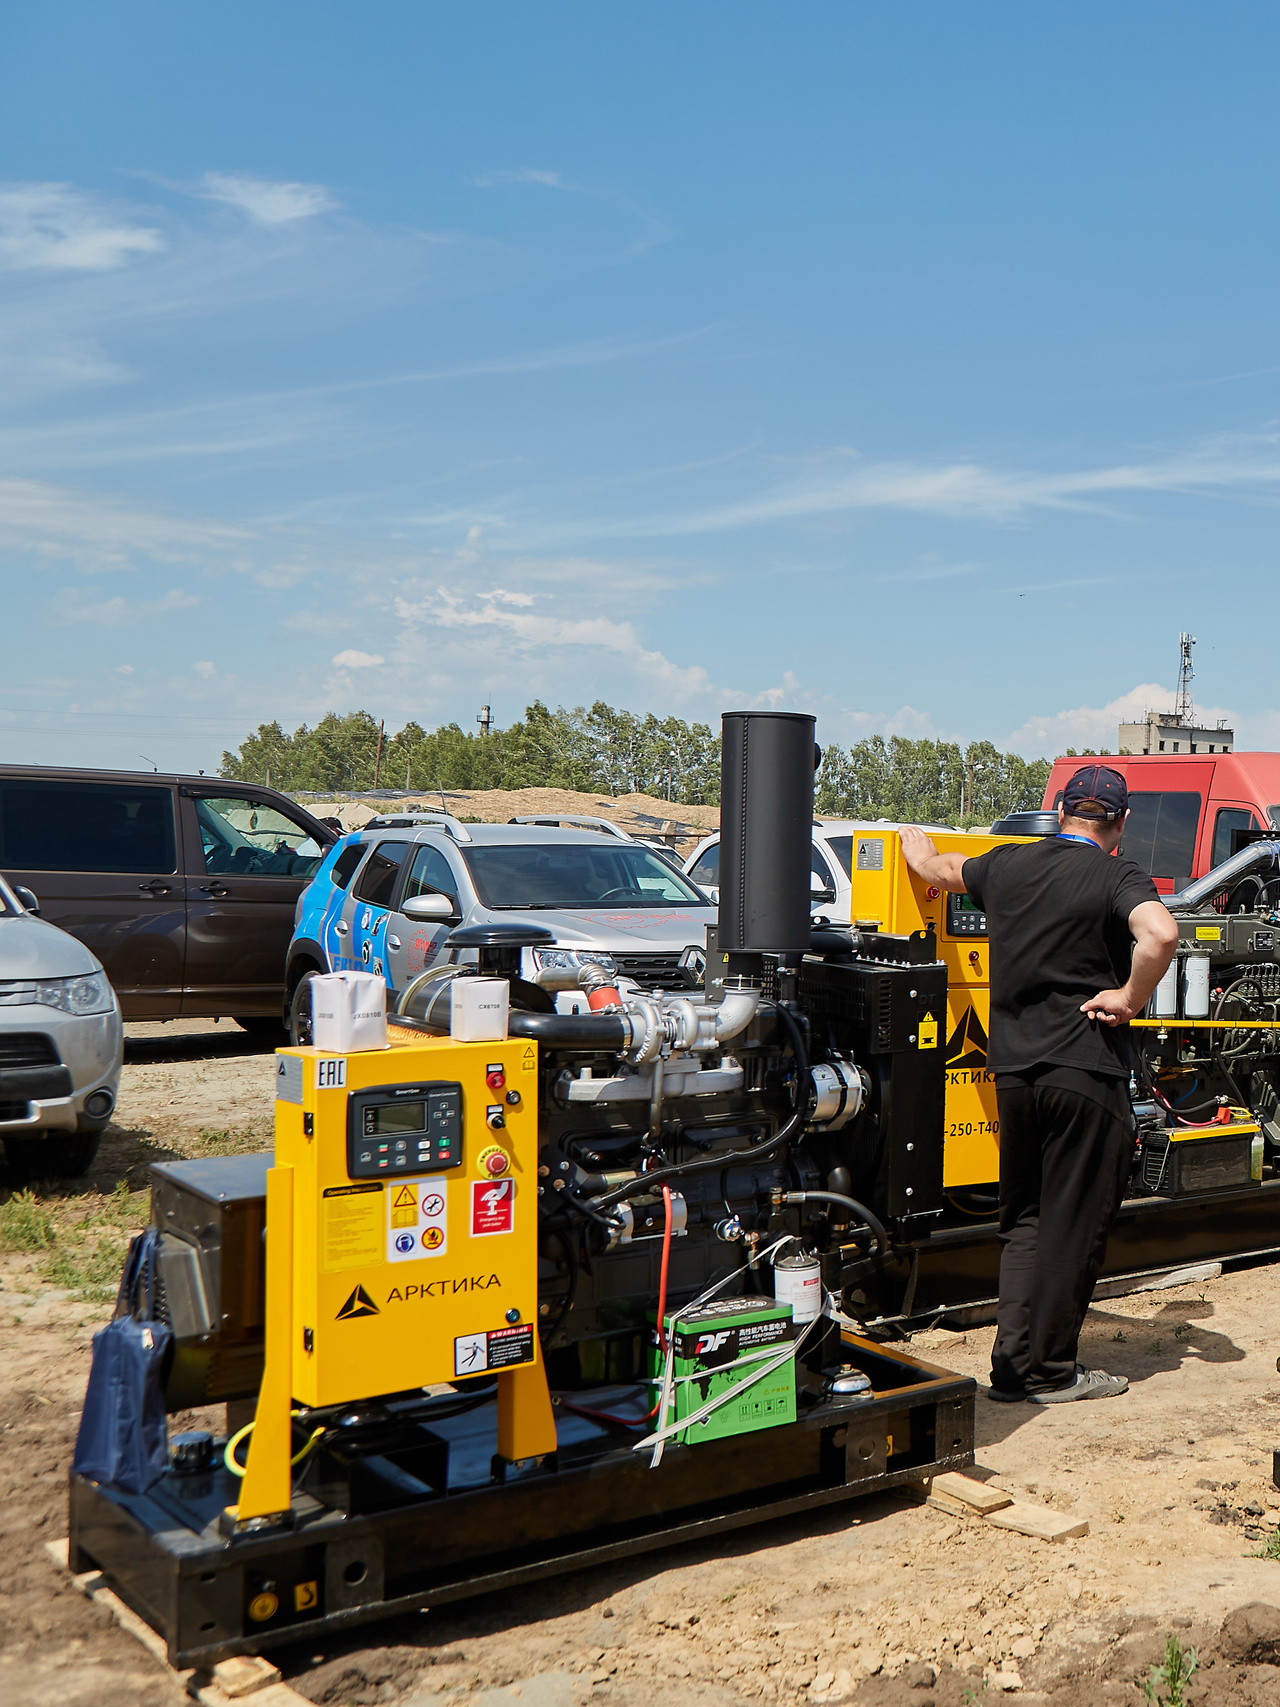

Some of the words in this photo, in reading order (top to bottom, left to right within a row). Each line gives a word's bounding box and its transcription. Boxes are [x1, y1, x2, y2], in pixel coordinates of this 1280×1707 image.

[319, 1060, 345, 1086] EAC
[386, 1273, 502, 1304] АРКТИКА
[496, 1326, 528, 1337] WARNING
[695, 1330, 732, 1355] DF
